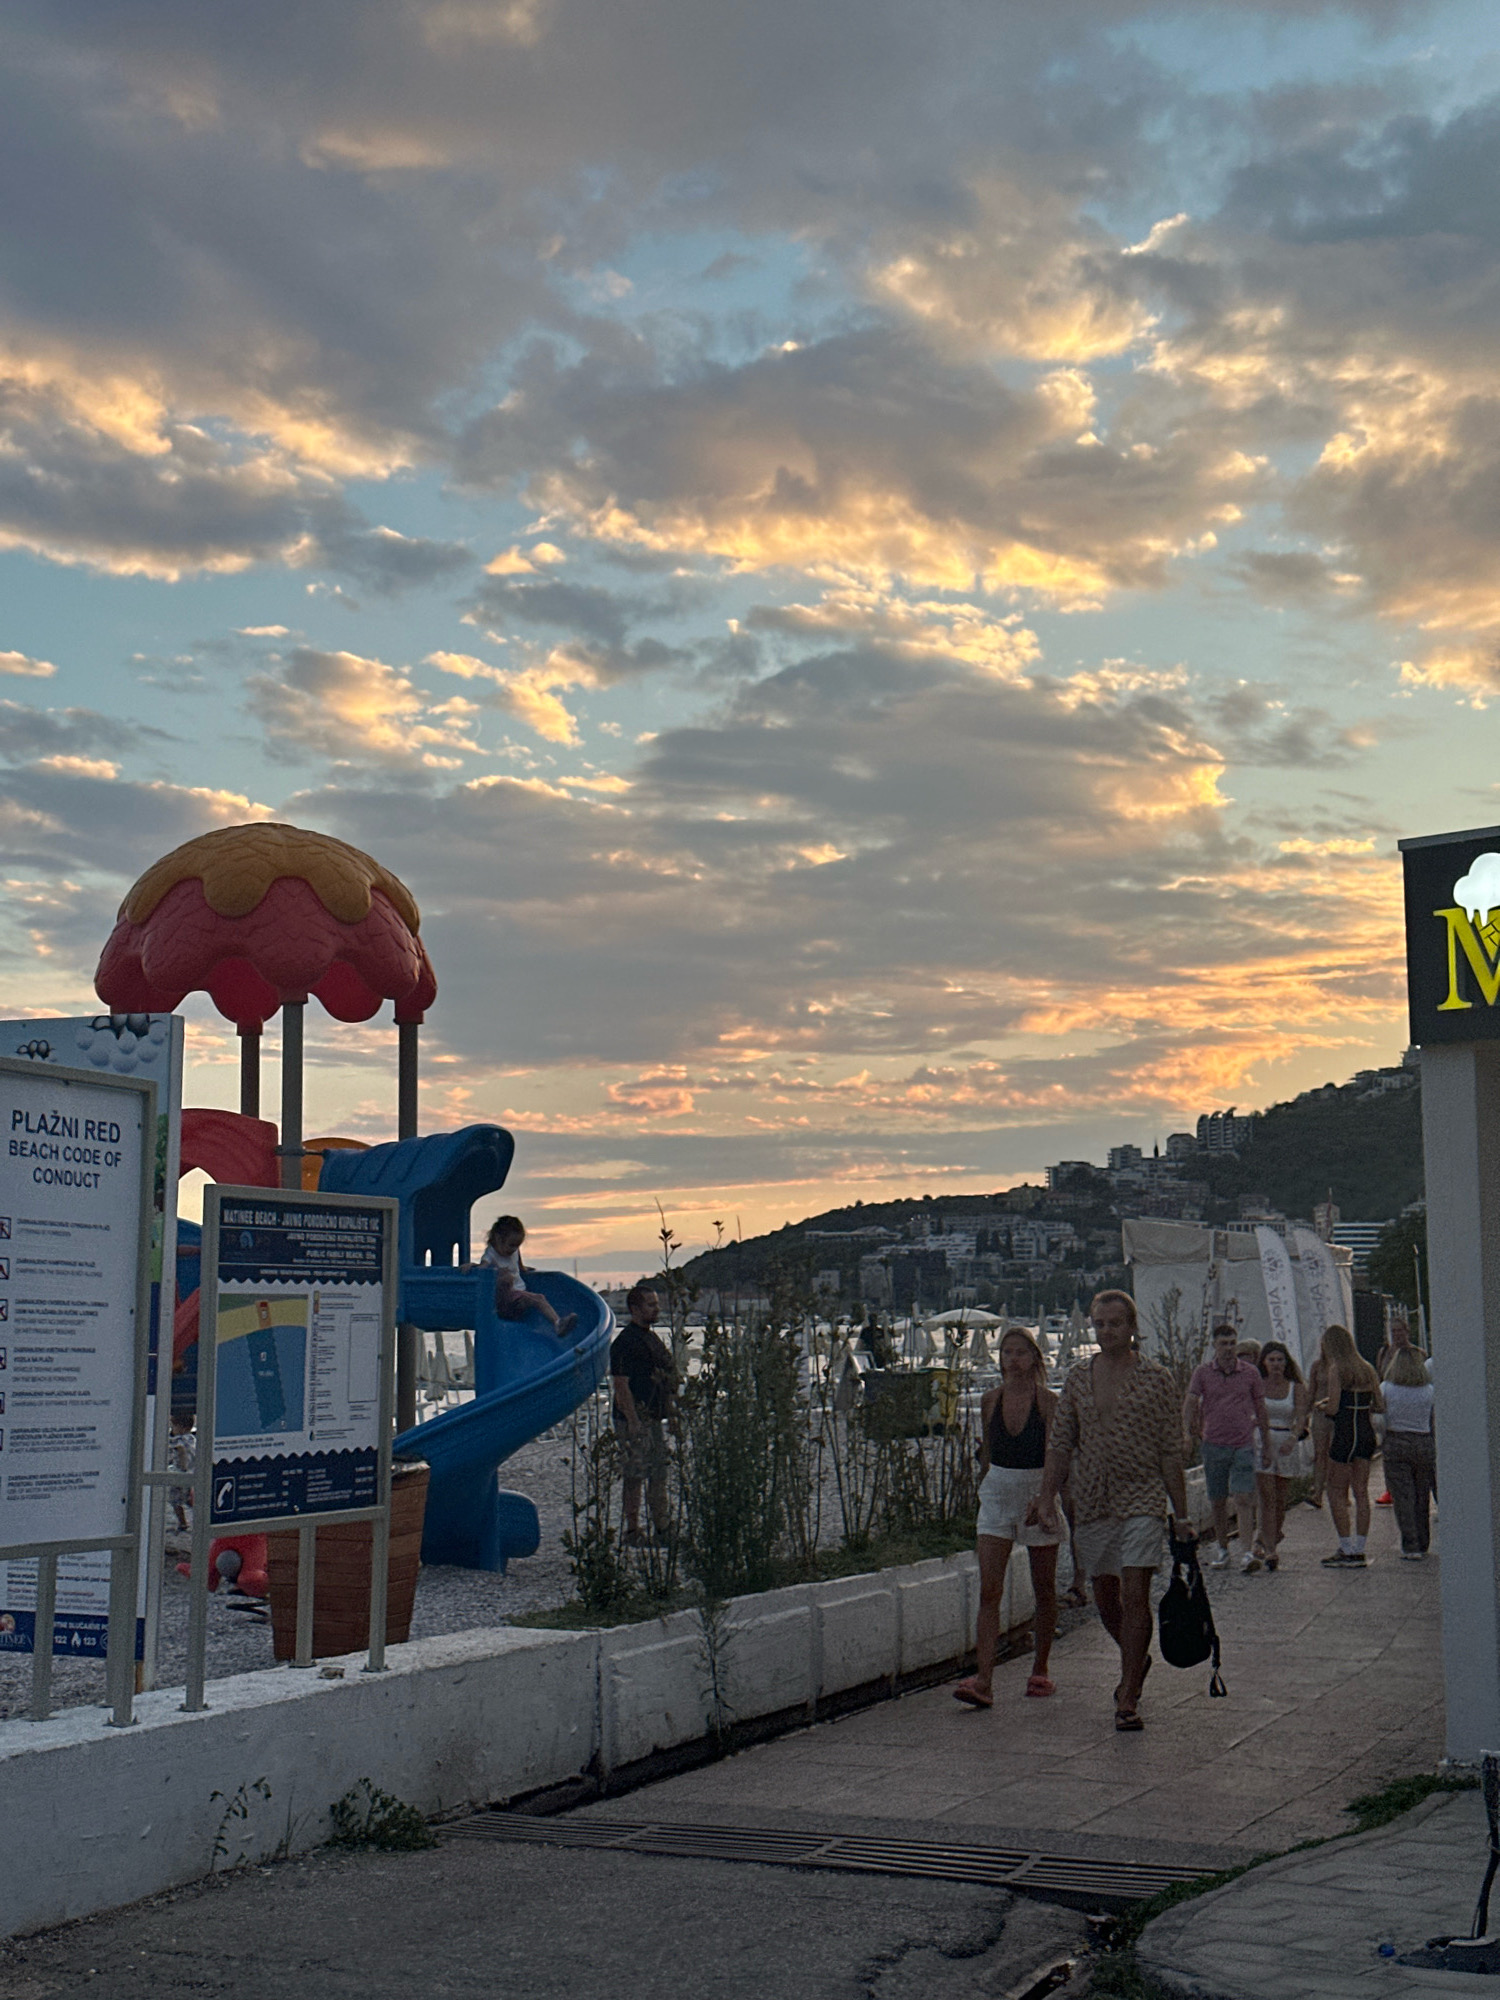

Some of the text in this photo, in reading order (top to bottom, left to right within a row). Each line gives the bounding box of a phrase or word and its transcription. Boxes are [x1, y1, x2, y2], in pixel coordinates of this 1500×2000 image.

[11, 1109, 121, 1143] PLAŽNI RED
[8, 1139, 122, 1167] BEACH CODE OF
[32, 1166, 101, 1189] CONDUCT
[255, 1211, 277, 1226] BEACH
